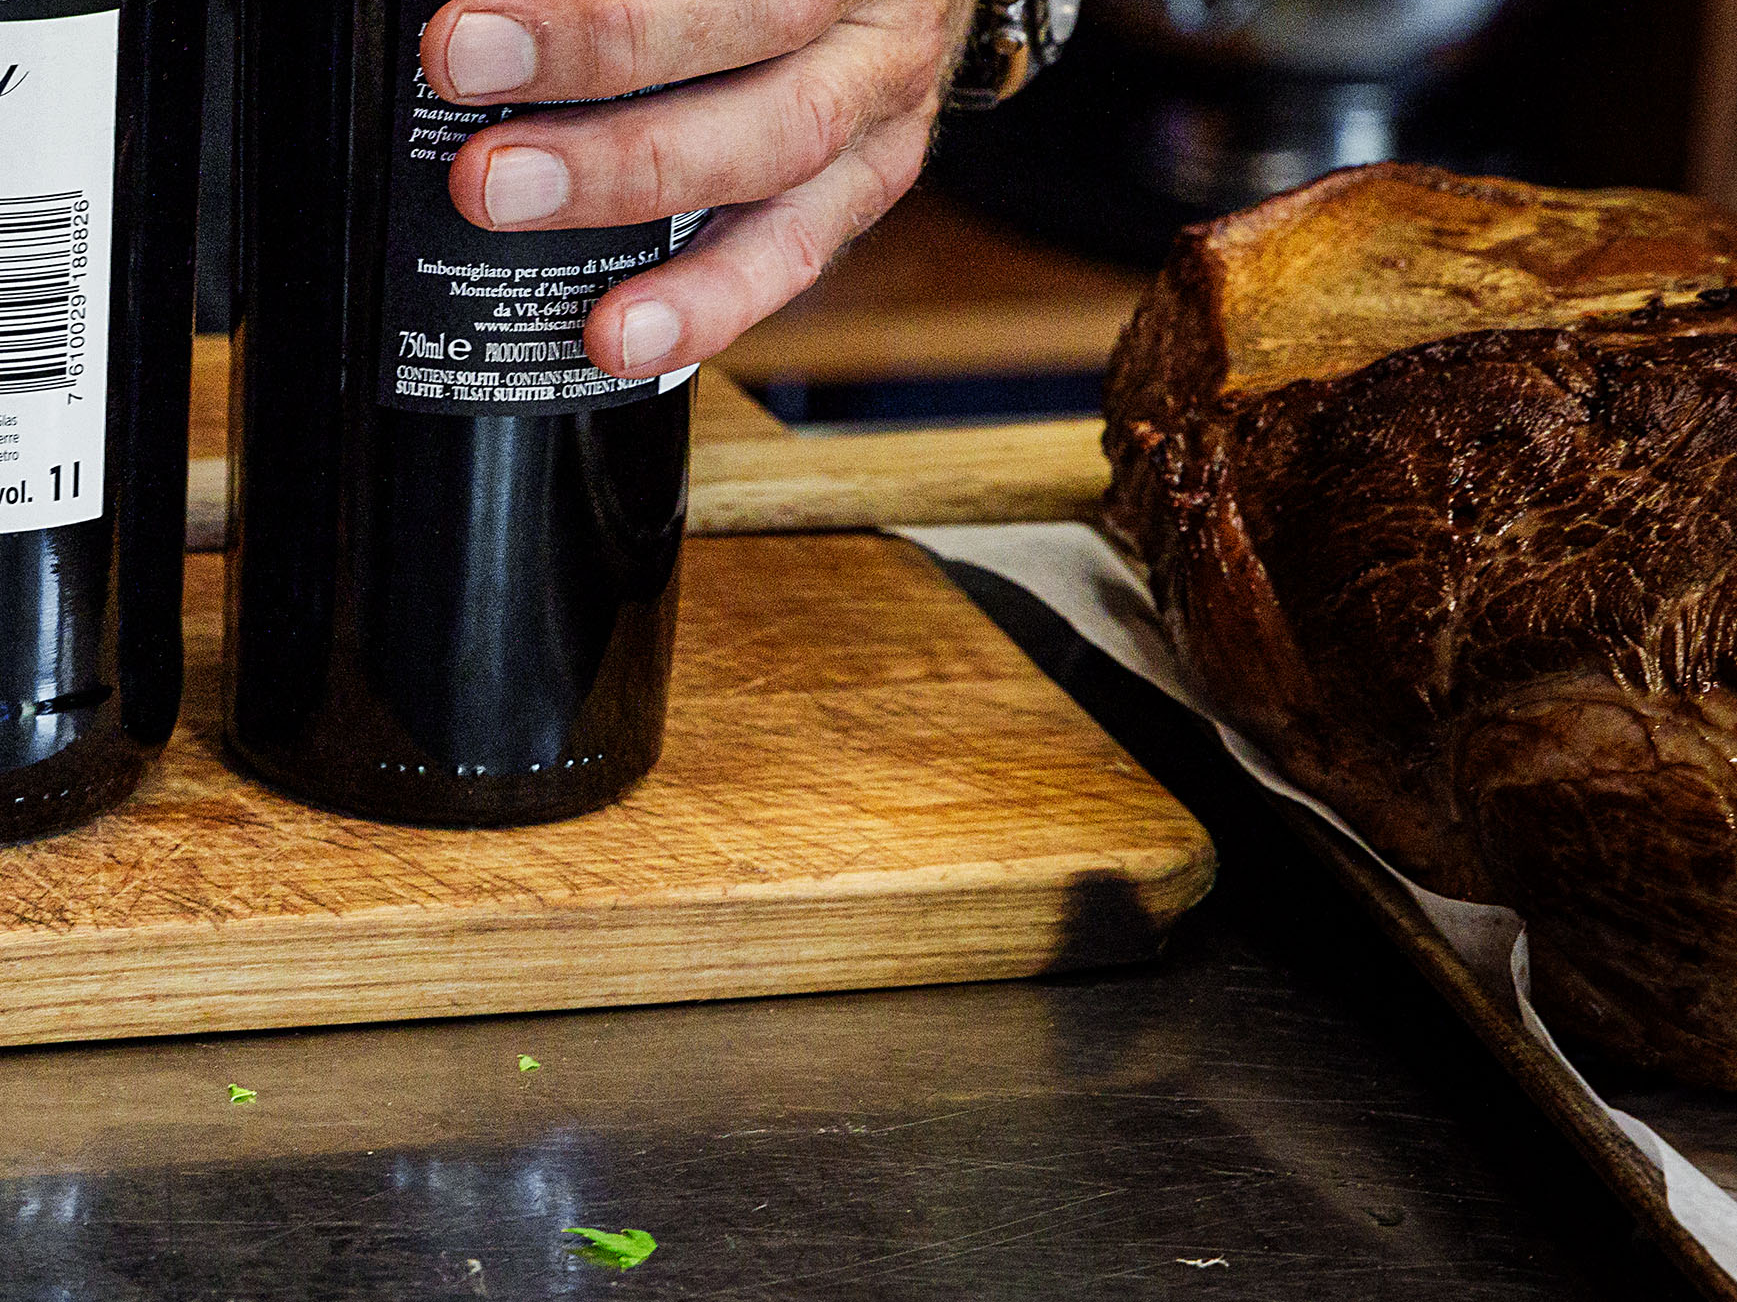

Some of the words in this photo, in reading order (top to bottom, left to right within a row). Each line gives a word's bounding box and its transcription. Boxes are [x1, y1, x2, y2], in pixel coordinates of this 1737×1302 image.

[412, 107, 490, 123] maturare.
[409, 147, 436, 160] con
[71, 199, 91, 282] 186826
[417, 258, 512, 281] Imbottigliato
[514, 264, 539, 283] per
[540, 263, 581, 278] conto
[582, 259, 597, 274] di
[599, 253, 637, 273] Mabis
[449, 281, 532, 298] Monteforte
[534, 279, 596, 300] d'Alpone
[493, 303, 512, 318] da
[514, 300, 579, 319] VR-6498
[68, 294, 87, 377] 610029
[398, 331, 445, 360] 750ml
[484, 341, 547, 363] PRODOTTO
[547, 341, 562, 361] IN
[396, 364, 455, 385] CONTIENE
[506, 370, 563, 387] CONTAINS
[67, 392, 84, 407] 7
[395, 380, 445, 399] SULFITE
[451, 386, 493, 401] TILSAT
[493, 386, 556, 402] SULFITTER
[562, 379, 616, 399] CONTIENT
